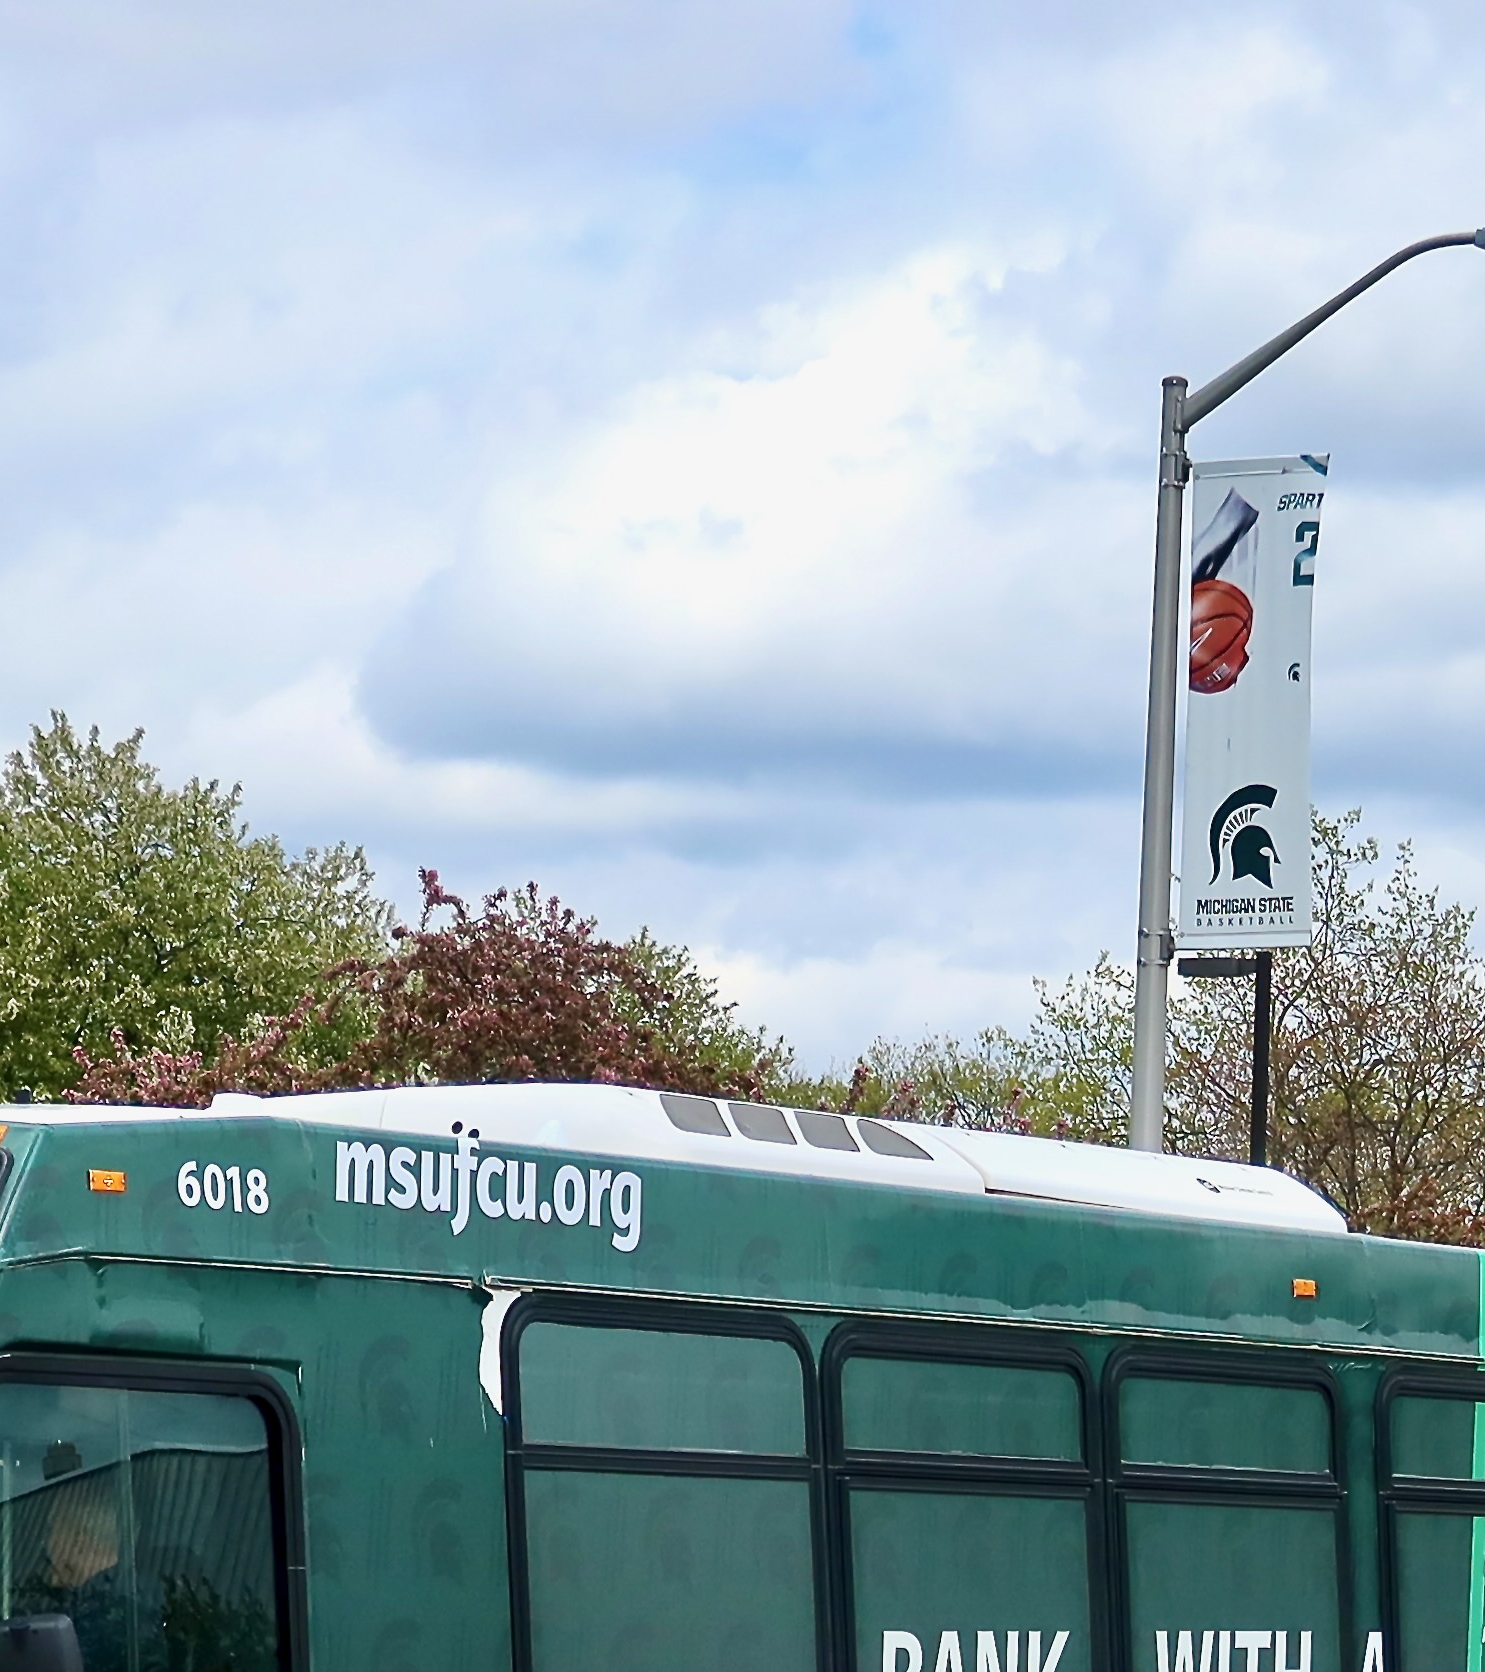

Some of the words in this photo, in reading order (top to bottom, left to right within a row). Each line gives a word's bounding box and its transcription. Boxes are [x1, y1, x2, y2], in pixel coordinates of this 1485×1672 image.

[1196, 898, 1255, 915] MICHIGAN
[1258, 896, 1294, 913] STATE
[1196, 916, 1293, 927] BASKETBALL
[177, 1161, 269, 1215] 6018
[335, 1136, 642, 1252] msufcu.org
